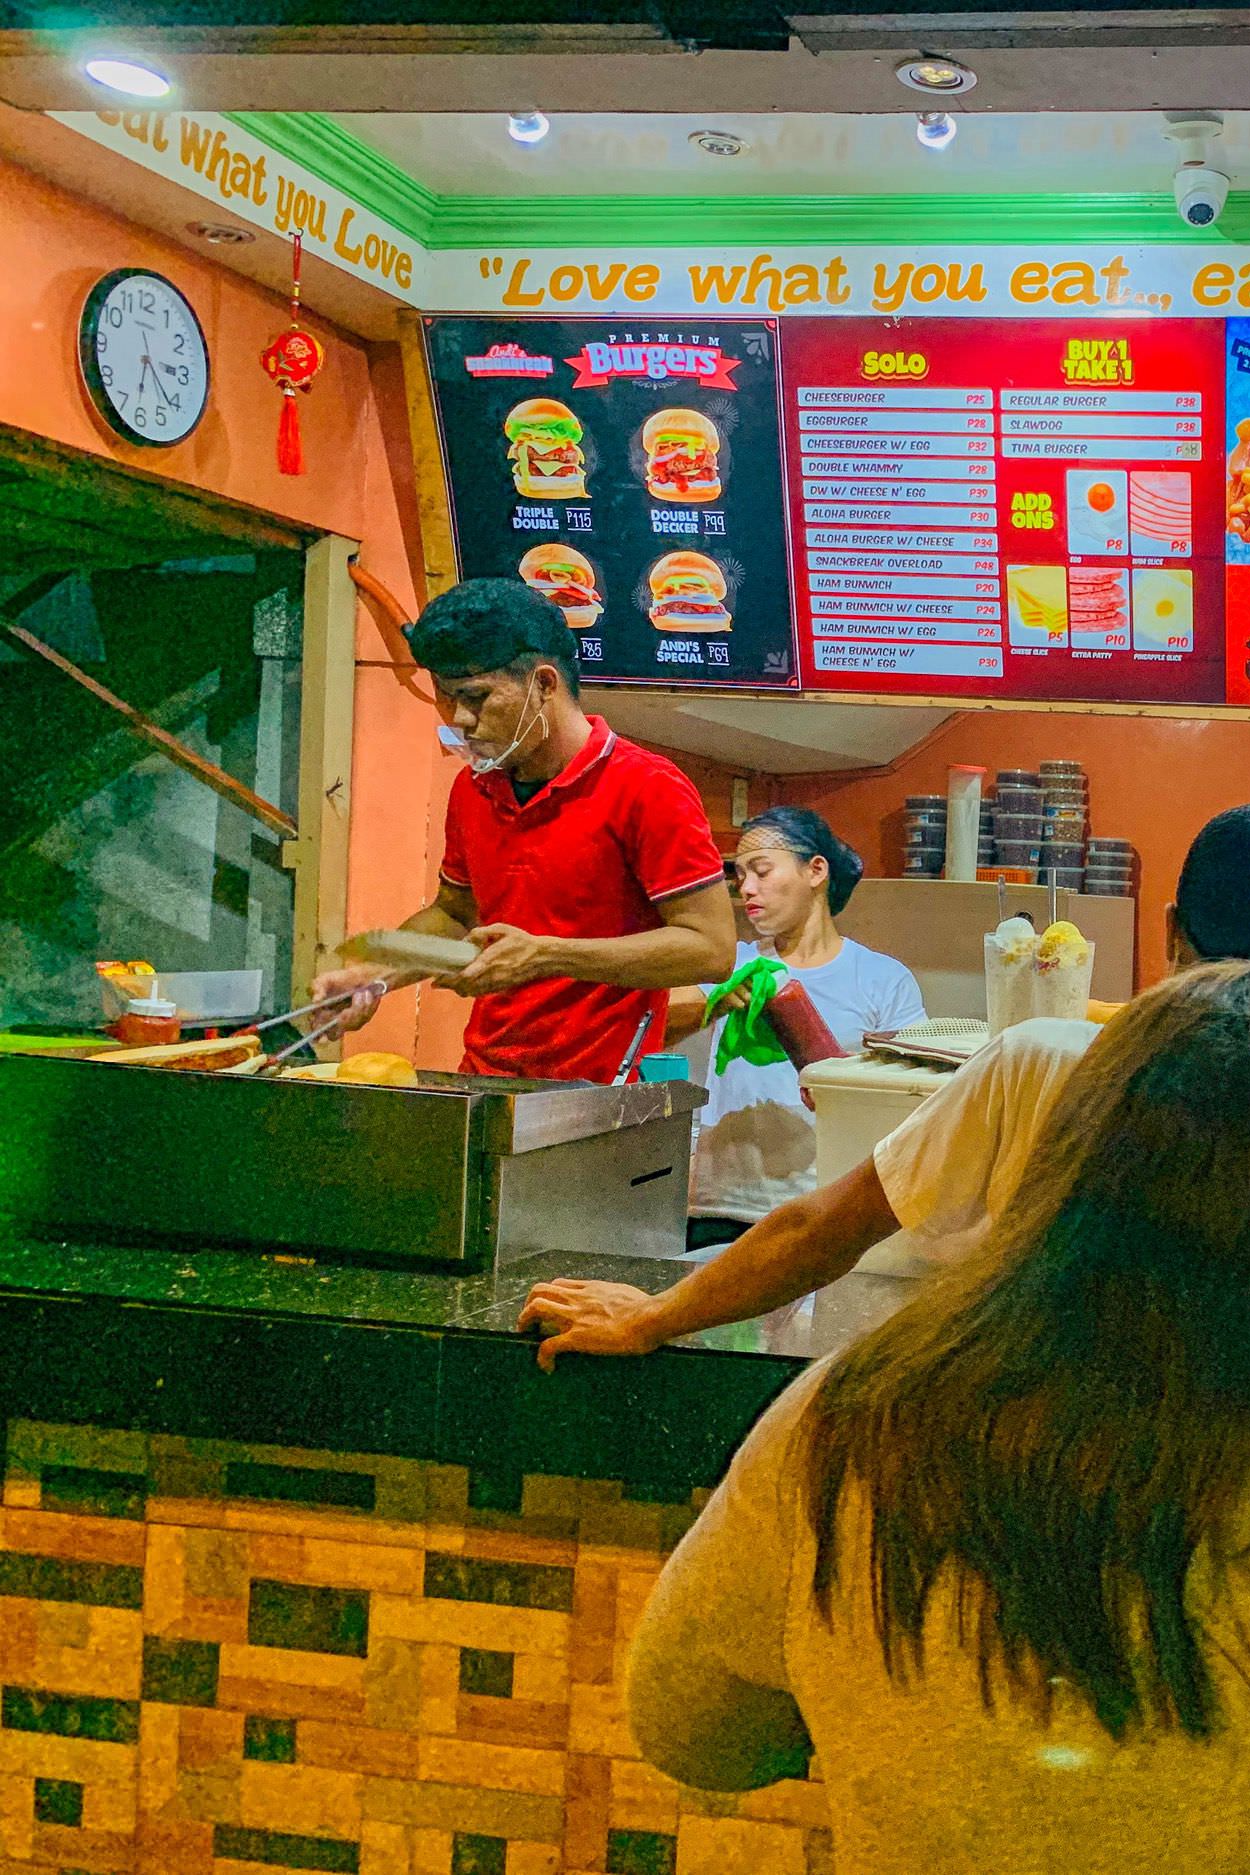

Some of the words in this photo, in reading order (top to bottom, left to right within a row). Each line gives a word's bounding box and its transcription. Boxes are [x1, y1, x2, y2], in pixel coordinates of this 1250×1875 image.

[180, 117, 267, 206] what
[275, 176, 327, 243] you
[334, 208, 412, 290] Love
[688, 255, 851, 312] what
[871, 257, 988, 312] you
[608, 333, 721, 347] PREMIUM
[1067, 340, 1113, 360] BUY
[1117, 340, 1127, 360] 1
[585, 341, 718, 379] Burgers
[862, 350, 926, 375] SOLO
[1064, 360, 1118, 380] TAKE
[1121, 360, 1132, 380] 1
[805, 392, 885, 403] CHEESEBURGER
[966, 395, 985, 405] P25
[1010, 396, 1059, 407] REGULAR
[1063, 396, 1107, 407] BURGER
[1176, 397, 1195, 408] P38
[806, 416, 868, 427] EGGBURGER
[967, 419, 986, 429] P28
[1010, 420, 1063, 431] SLAWDOG
[1176, 423, 1195, 433] P38
[808, 439, 888, 450] CHEESEBURGER
[891, 440, 907, 450] W/
[910, 441, 930, 451] EGG
[968, 441, 987, 451] P32
[1011, 443, 1040, 454] TUNA
[1044, 444, 1088, 454] BURGER
[809, 463, 849, 472] DOUBLE
[852, 464, 903, 474] WHAMMY
[968, 465, 988, 475] P28
[810, 486, 828, 496] DW
[831, 487, 847, 496] W/
[850, 487, 888, 497] CHEESE
[891, 487, 902, 497] N'
[906, 488, 926, 498] EGG
[969, 489, 988, 499] P39
[1011, 493, 1052, 511] ADD
[516, 506, 554, 518] TRIPLE
[651, 509, 699, 522] DOUBLE
[811, 509, 847, 519] ALOHA
[849, 510, 891, 520] BURGER
[970, 512, 989, 522] P30
[513, 517, 559, 531] DOUBLE
[1011, 512, 1054, 529] ONS
[652, 521, 699, 534] DECKER
[814, 534, 848, 544] ALOHA
[852, 535, 893, 545] BURGER
[897, 536, 914, 546] W/
[916, 536, 955, 547] CHEESE
[973, 538, 993, 548] P34
[1107, 539, 1123, 551] P8
[1171, 541, 1186, 553] P8
[815, 557, 884, 567] SNACKBREAK
[887, 559, 943, 569] OVERLOAD
[975, 561, 993, 571] P48
[817, 578, 841, 589] HAM
[844, 579, 892, 590] BUNWICH
[976, 583, 994, 593] P20
[819, 601, 842, 611] HAM
[846, 602, 893, 612] BUNWICH
[897, 603, 913, 613] W/
[915, 604, 953, 614] CHEESE
[977, 605, 995, 615] P24
[1048, 632, 1063, 642] P5
[1105, 635, 1126, 646] P10
[1168, 637, 1188, 648] P10
[659, 640, 700, 652] ANDI'S
[822, 645, 845, 655] HAM
[849, 646, 896, 656] BUNWICH
[899, 647, 915, 657] W/
[656, 651, 704, 664] SPECIAL
[822, 657, 859, 667] CHEESE
[862, 657, 873, 667] N'
[877, 658, 896, 668] EGG
[979, 658, 998, 668] P30
